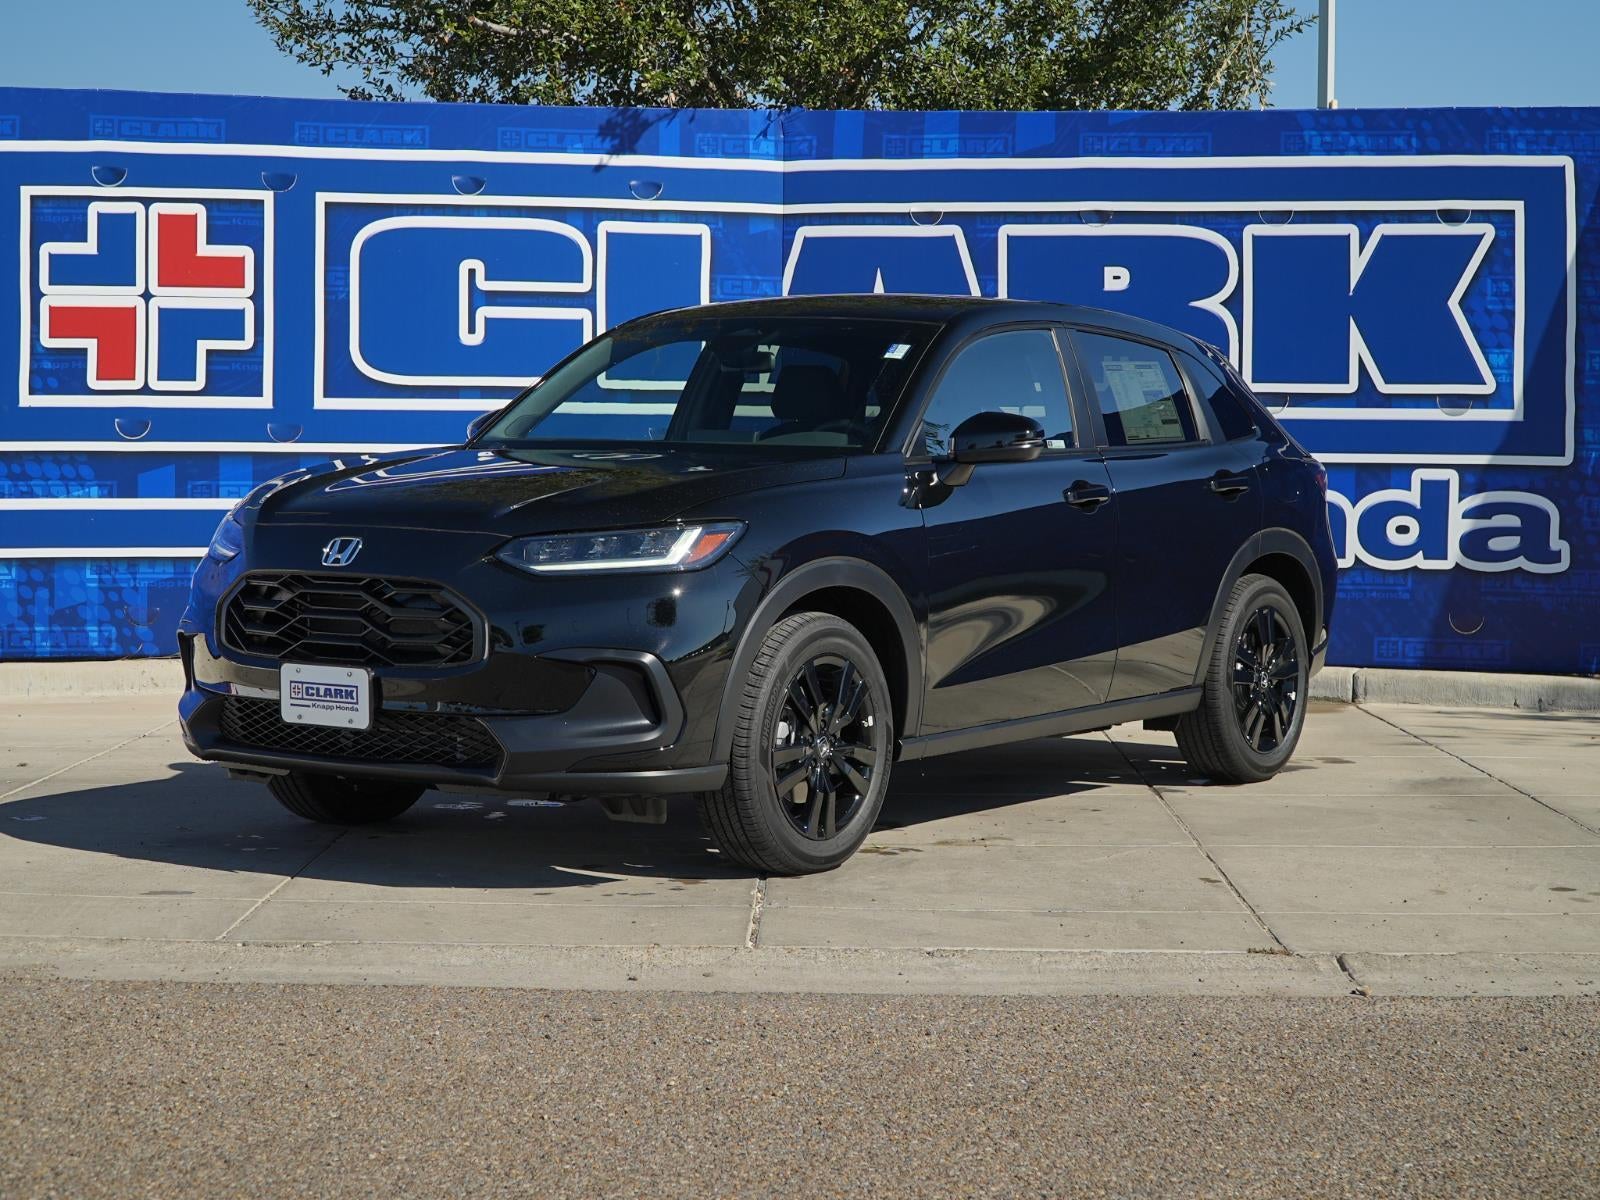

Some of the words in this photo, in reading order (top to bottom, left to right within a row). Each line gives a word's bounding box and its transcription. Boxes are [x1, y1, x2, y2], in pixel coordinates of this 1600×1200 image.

[120, 120, 219, 137] CLARK
[326, 127, 424, 144] CLARK
[305, 686, 354, 700] CLARK
[311, 702, 334, 711] Knapp
